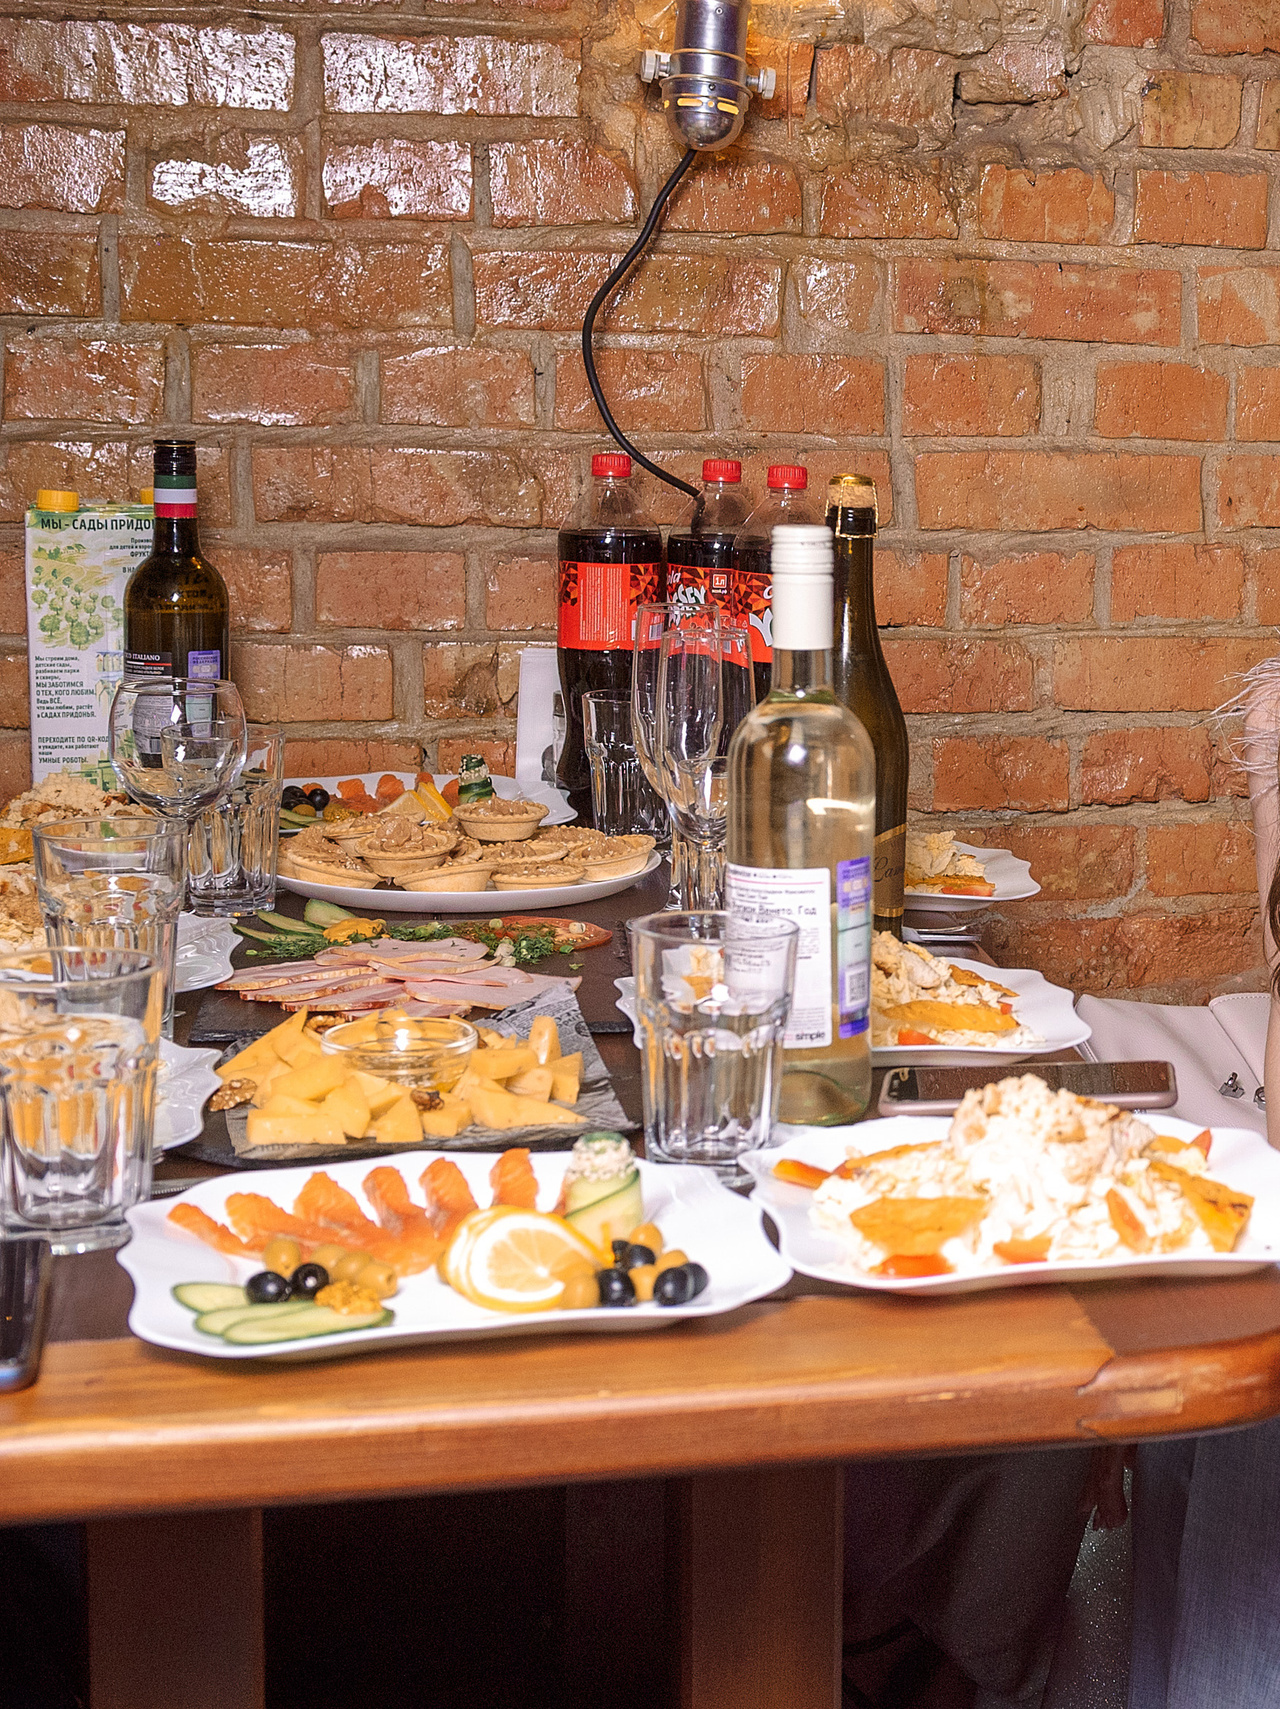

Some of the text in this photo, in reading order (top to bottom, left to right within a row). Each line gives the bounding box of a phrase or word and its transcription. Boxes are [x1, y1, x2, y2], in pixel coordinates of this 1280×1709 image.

[41, 518, 62, 530] МЫ
[72, 519, 108, 531] САДЫ
[715, 577, 725, 586] 1л
[132, 653, 160, 661] ITALIANO
[41, 689, 55, 697] ТЕХ,
[50, 697, 63, 705] ВСЁ,
[62, 711, 97, 719] ПРИДОНЬЯ.
[795, 1031, 825, 1042] simple
